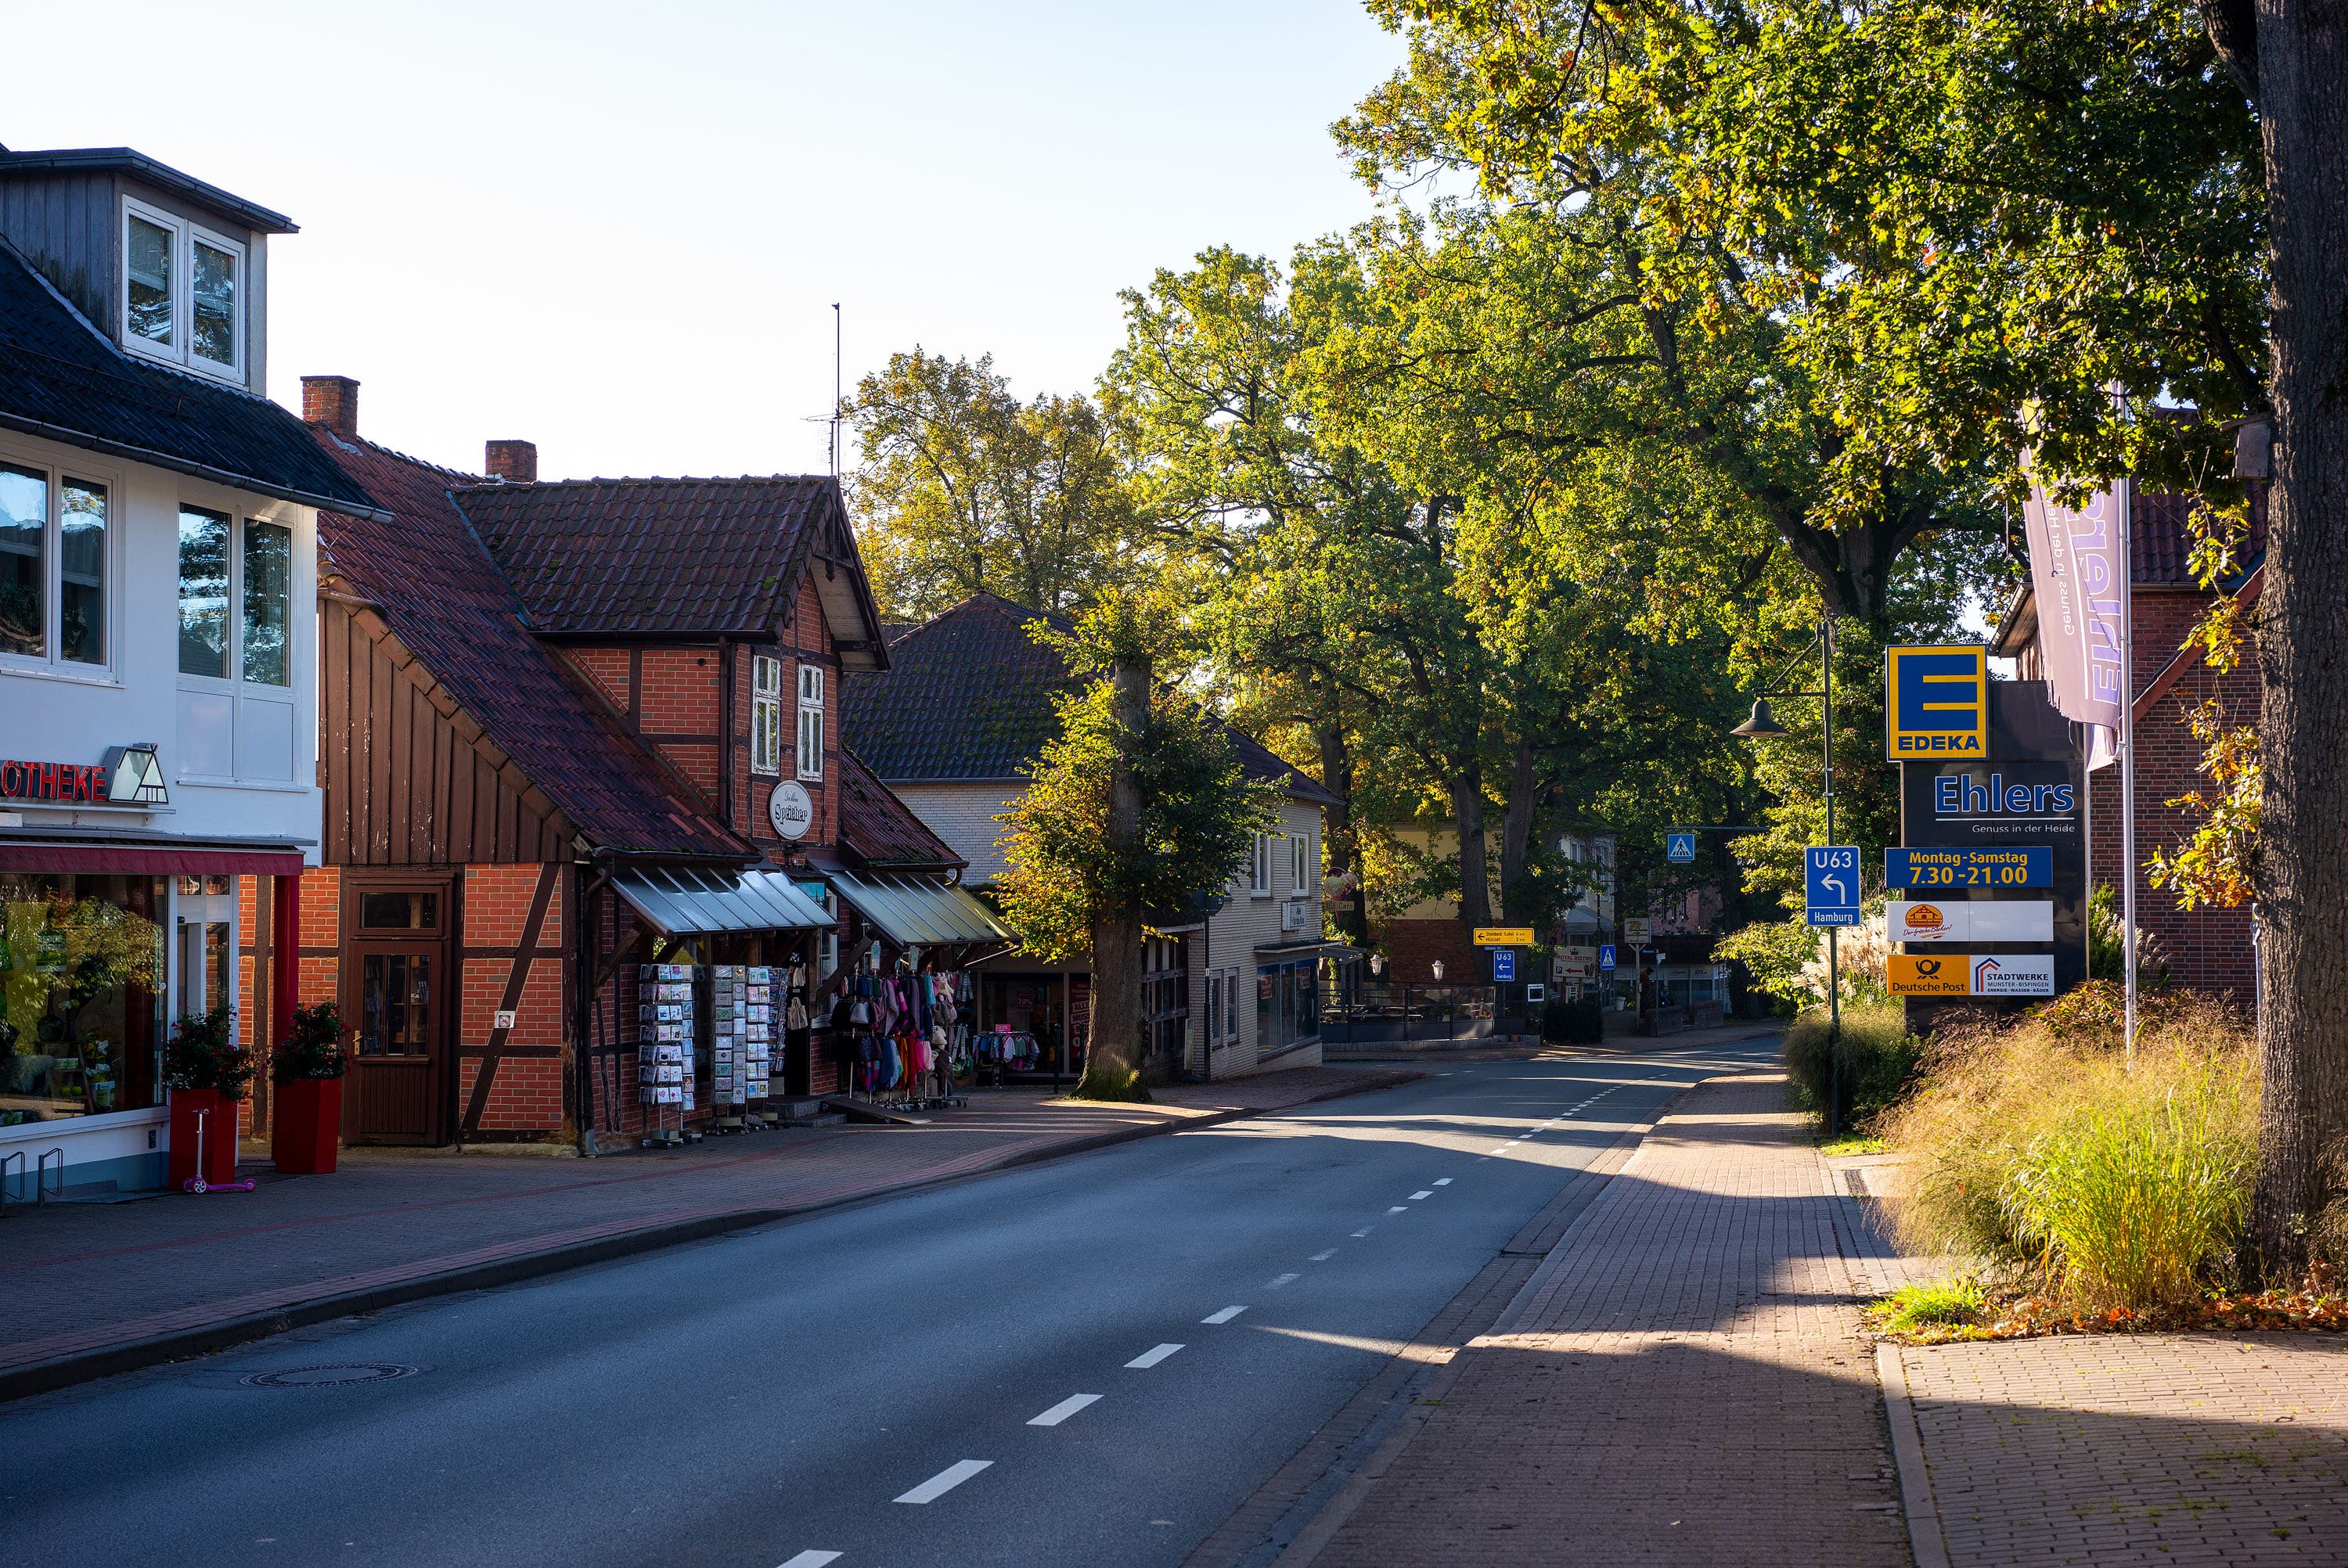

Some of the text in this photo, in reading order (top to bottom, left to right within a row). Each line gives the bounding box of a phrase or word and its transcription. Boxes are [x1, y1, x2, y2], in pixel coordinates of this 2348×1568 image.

[1899, 736, 1980, 751] EDEKA
[1, 760, 107, 801] OTHEKE
[1935, 773, 2075, 813] Ehlers
[775, 804, 808, 825] Speicher
[1972, 824, 2075, 833] Genuss in der Heide
[1910, 866, 1954, 884] 7.30
[1814, 912, 1853, 924] Hamburg
[1892, 982, 1965, 992] Deutsche Post
